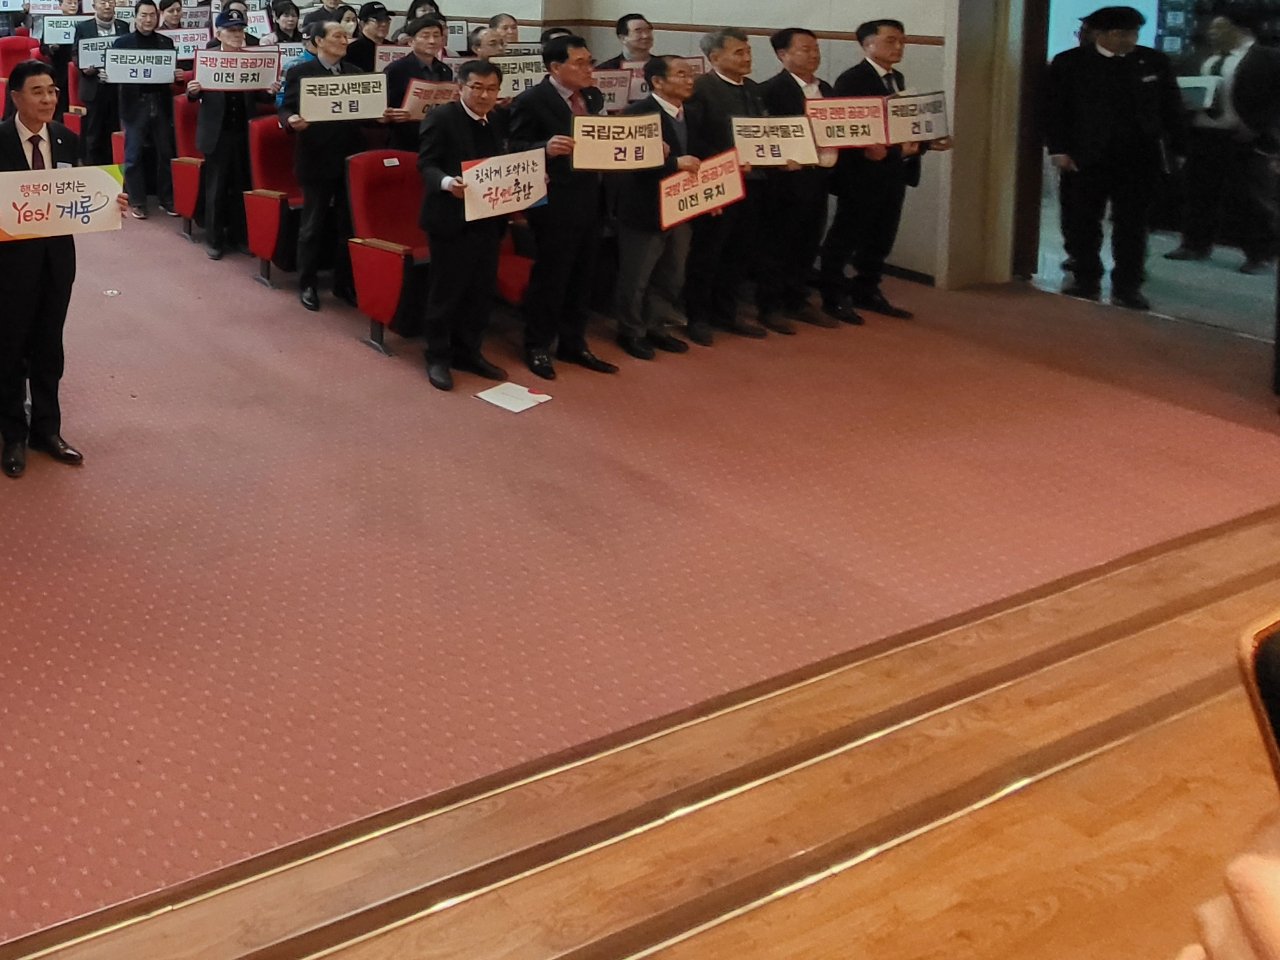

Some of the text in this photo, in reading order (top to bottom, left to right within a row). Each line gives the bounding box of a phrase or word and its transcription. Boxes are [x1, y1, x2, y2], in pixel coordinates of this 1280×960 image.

[110, 54, 172, 66] 국립군사박물관
[200, 57, 275, 68] 국방 관련 공공기관
[129, 68, 152, 78] 건 립
[213, 72, 260, 83] 이전 유치
[306, 81, 382, 96] 국립군사박물관
[331, 100, 359, 114] 건 립
[581, 122, 660, 141] 국립군사박물관
[735, 124, 805, 139] 국립군사박물관
[825, 123, 871, 138] 이전 유치
[614, 146, 645, 161] 건 립
[755, 144, 782, 158] 건 립
[475, 159, 539, 185] 힘차게 도약하는
[20, 180, 87, 198] 행복이 넘치는
[678, 183, 726, 212] 이전 유치
[12, 195, 94, 225] Yes! 계룡
